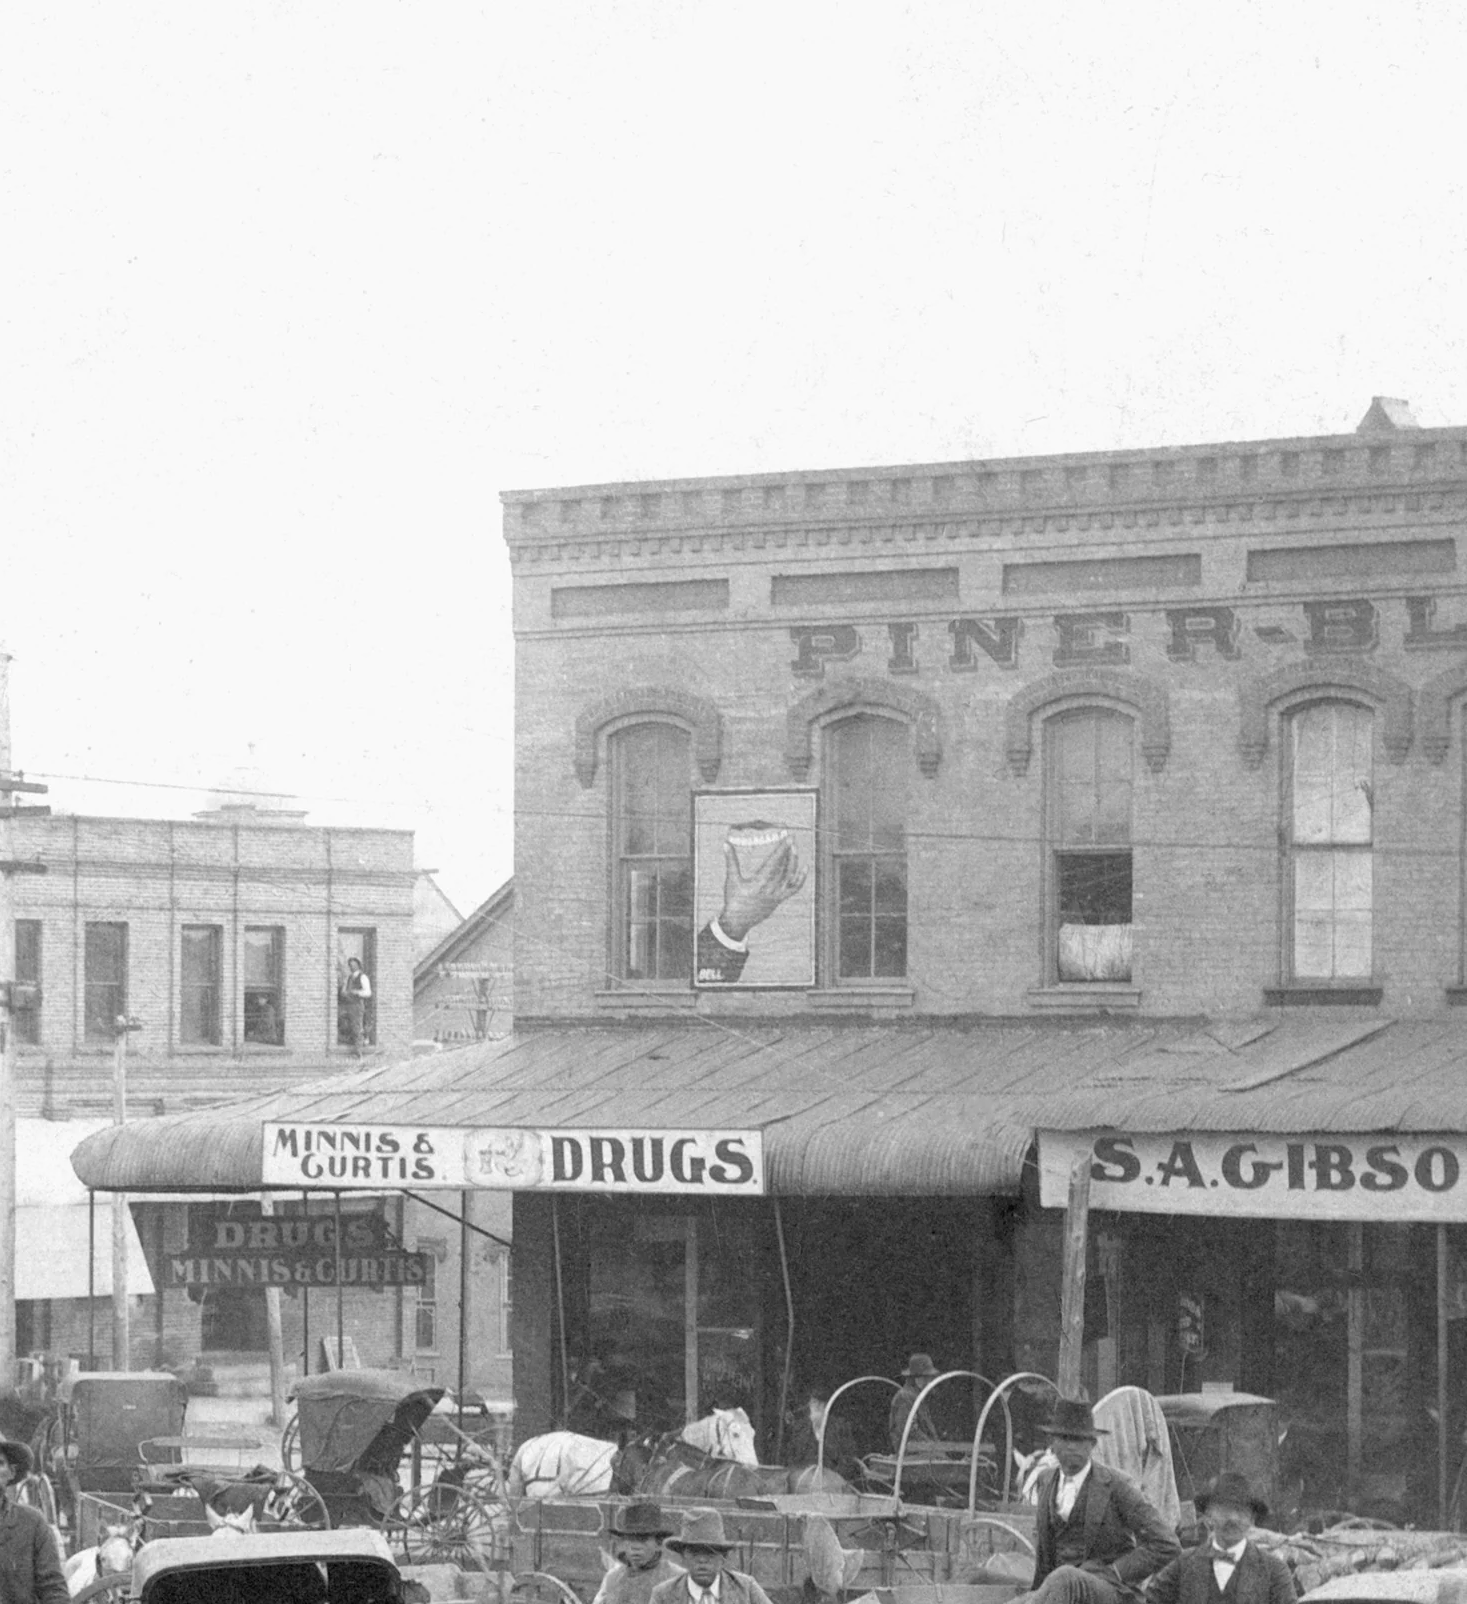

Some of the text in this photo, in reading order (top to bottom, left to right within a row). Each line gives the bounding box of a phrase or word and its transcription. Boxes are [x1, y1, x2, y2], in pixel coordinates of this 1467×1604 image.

[273, 1128, 435, 1158] MINNIS &
[551, 1136, 757, 1184] DRUGS.
[215, 1220, 373, 1249] DRUGS
